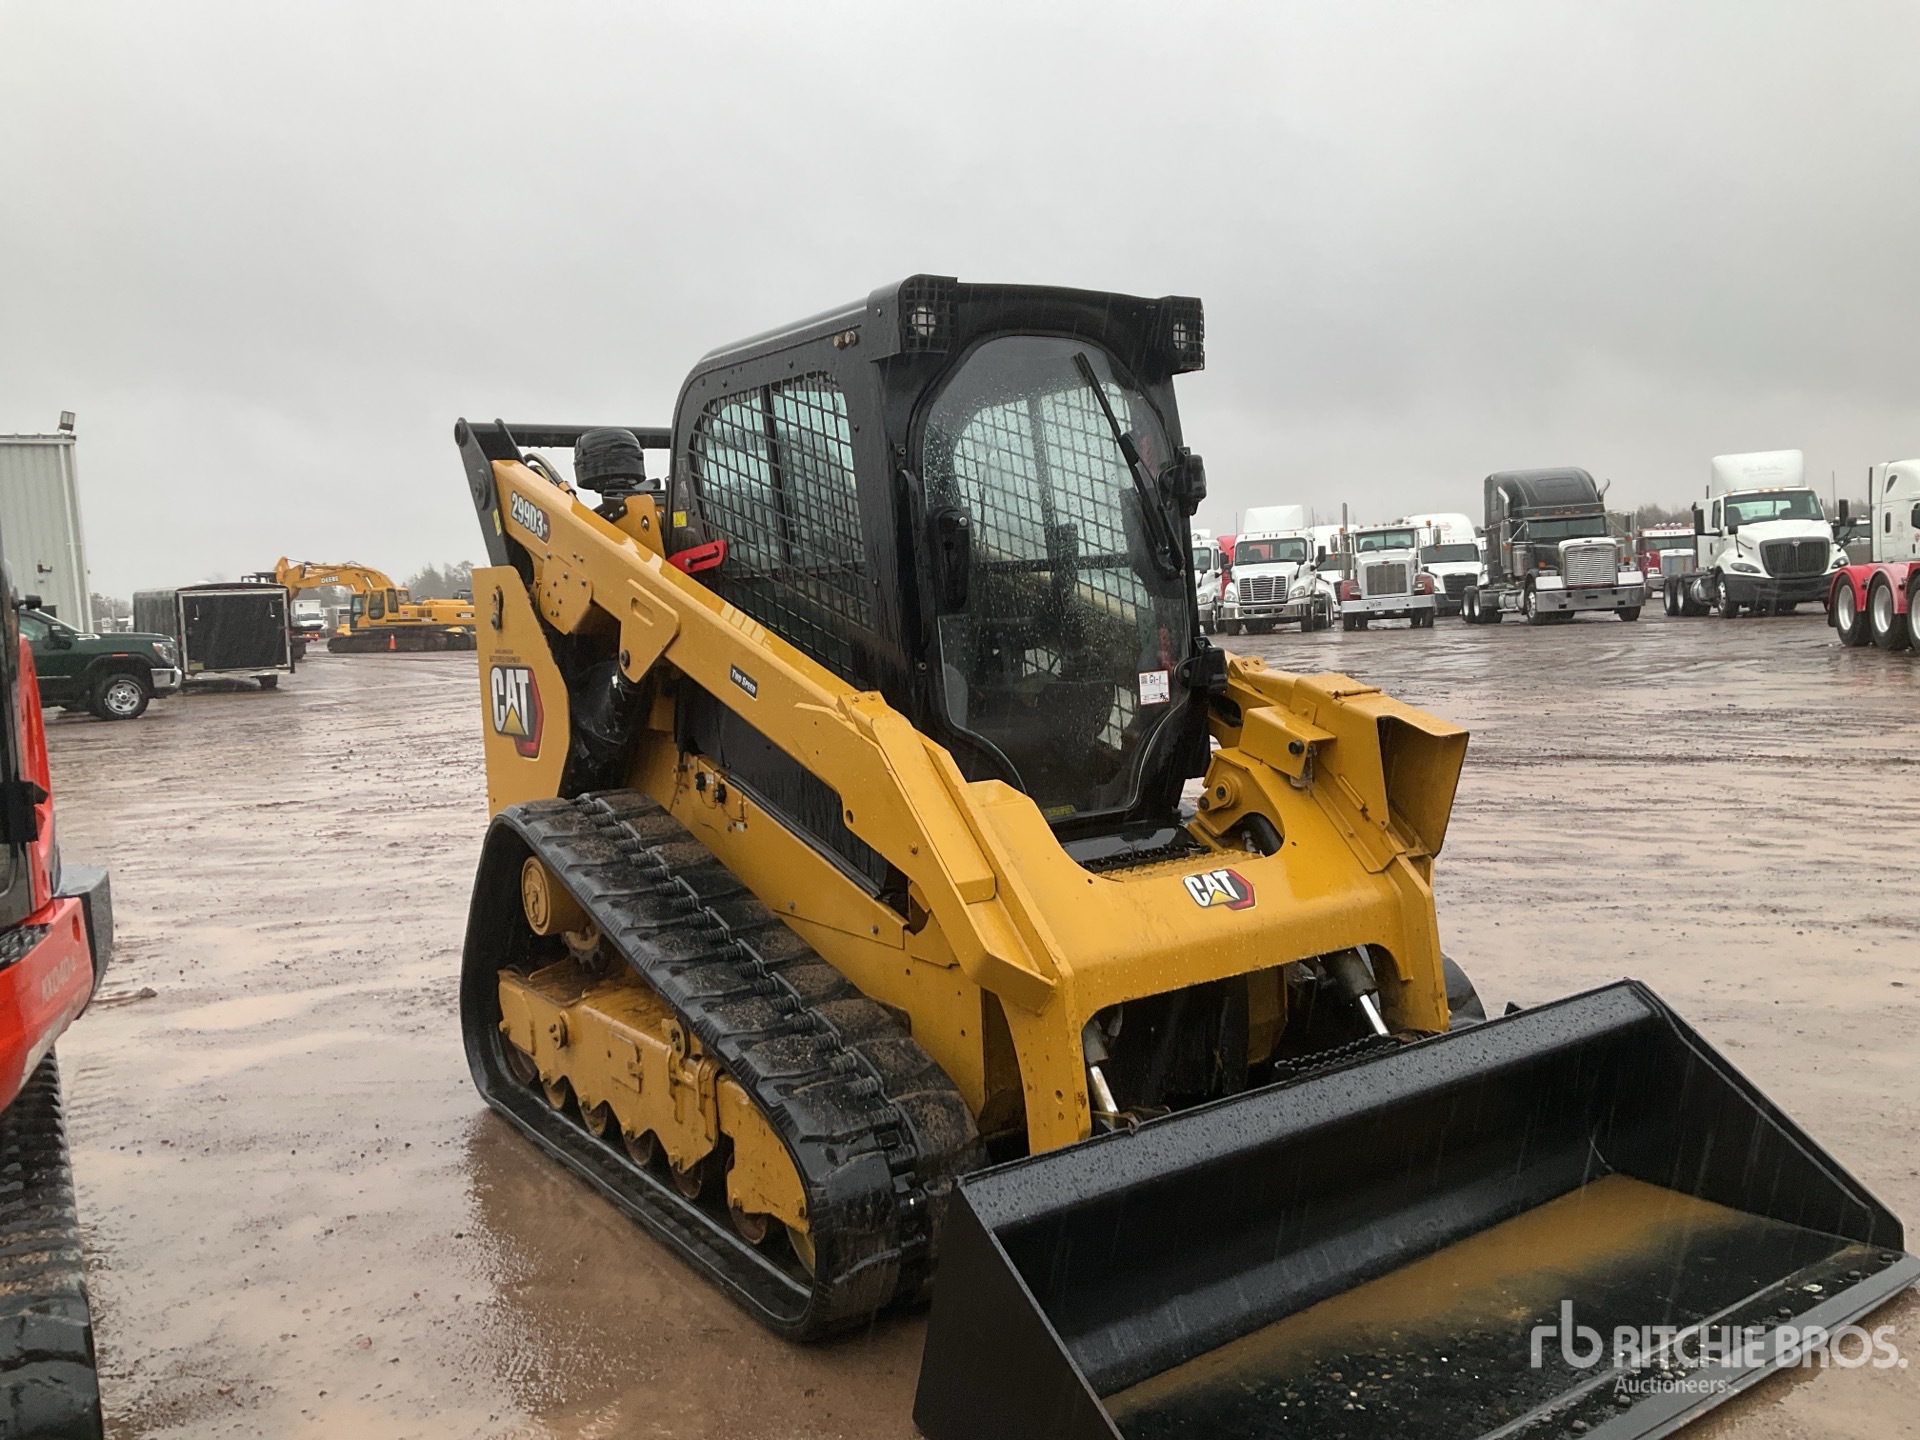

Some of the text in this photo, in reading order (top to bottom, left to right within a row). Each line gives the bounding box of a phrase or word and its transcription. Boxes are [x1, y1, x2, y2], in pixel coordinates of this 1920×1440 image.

[511, 490, 544, 538] 299D3
[320, 575, 339, 584] DEERE
[490, 666, 530, 736] CAT
[1184, 870, 1240, 907] CAT
